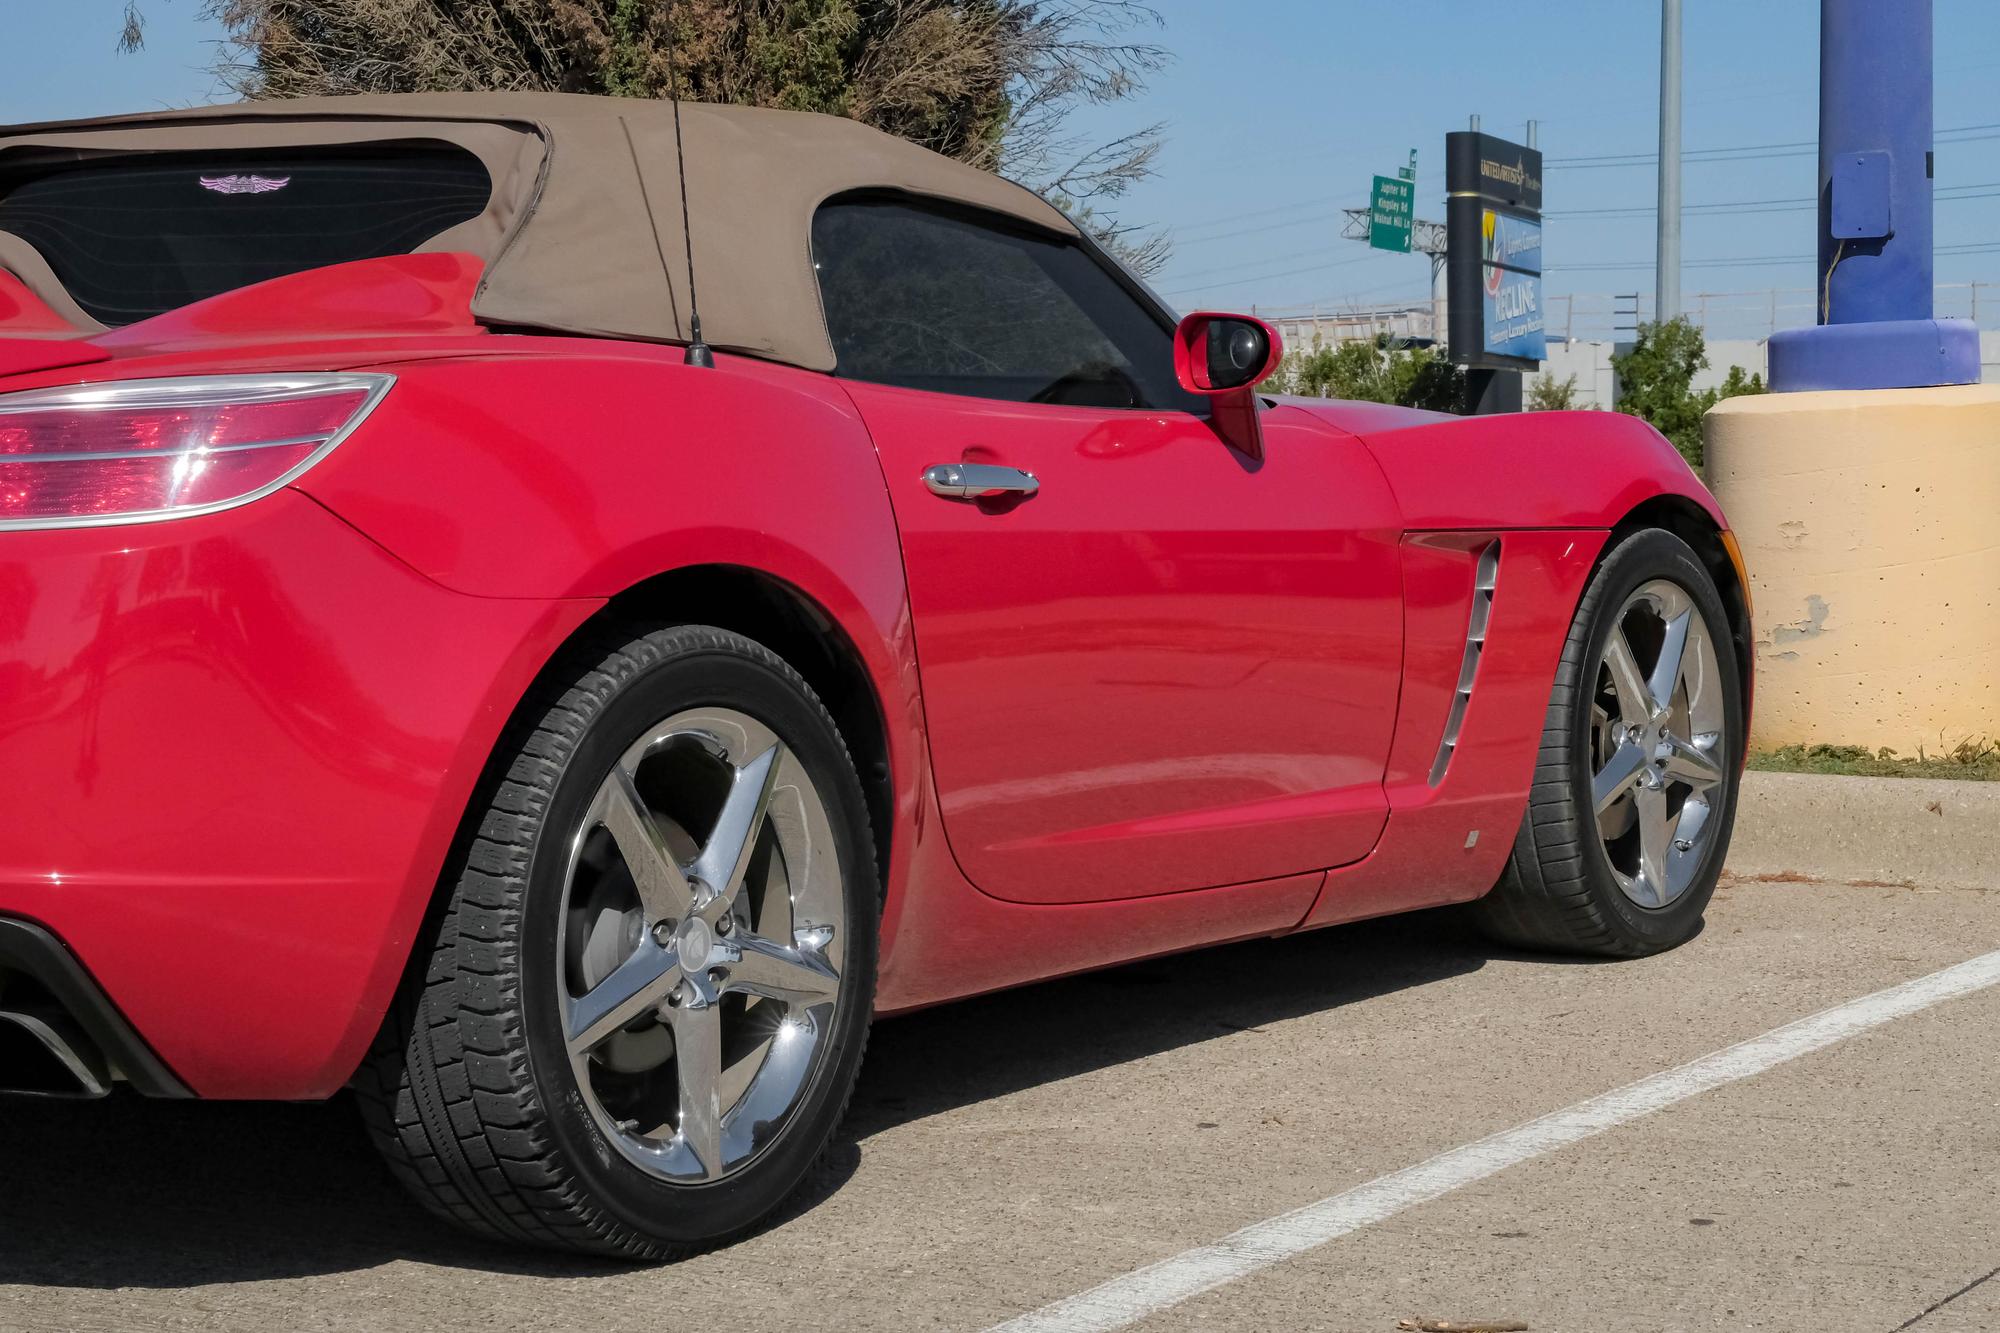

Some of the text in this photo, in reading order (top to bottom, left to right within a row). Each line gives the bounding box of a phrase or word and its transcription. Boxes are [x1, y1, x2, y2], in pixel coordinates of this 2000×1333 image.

[1400, 186, 1407, 197] Rd
[1401, 201, 1408, 213] Rd
[1496, 280, 1536, 323] RECLINE
